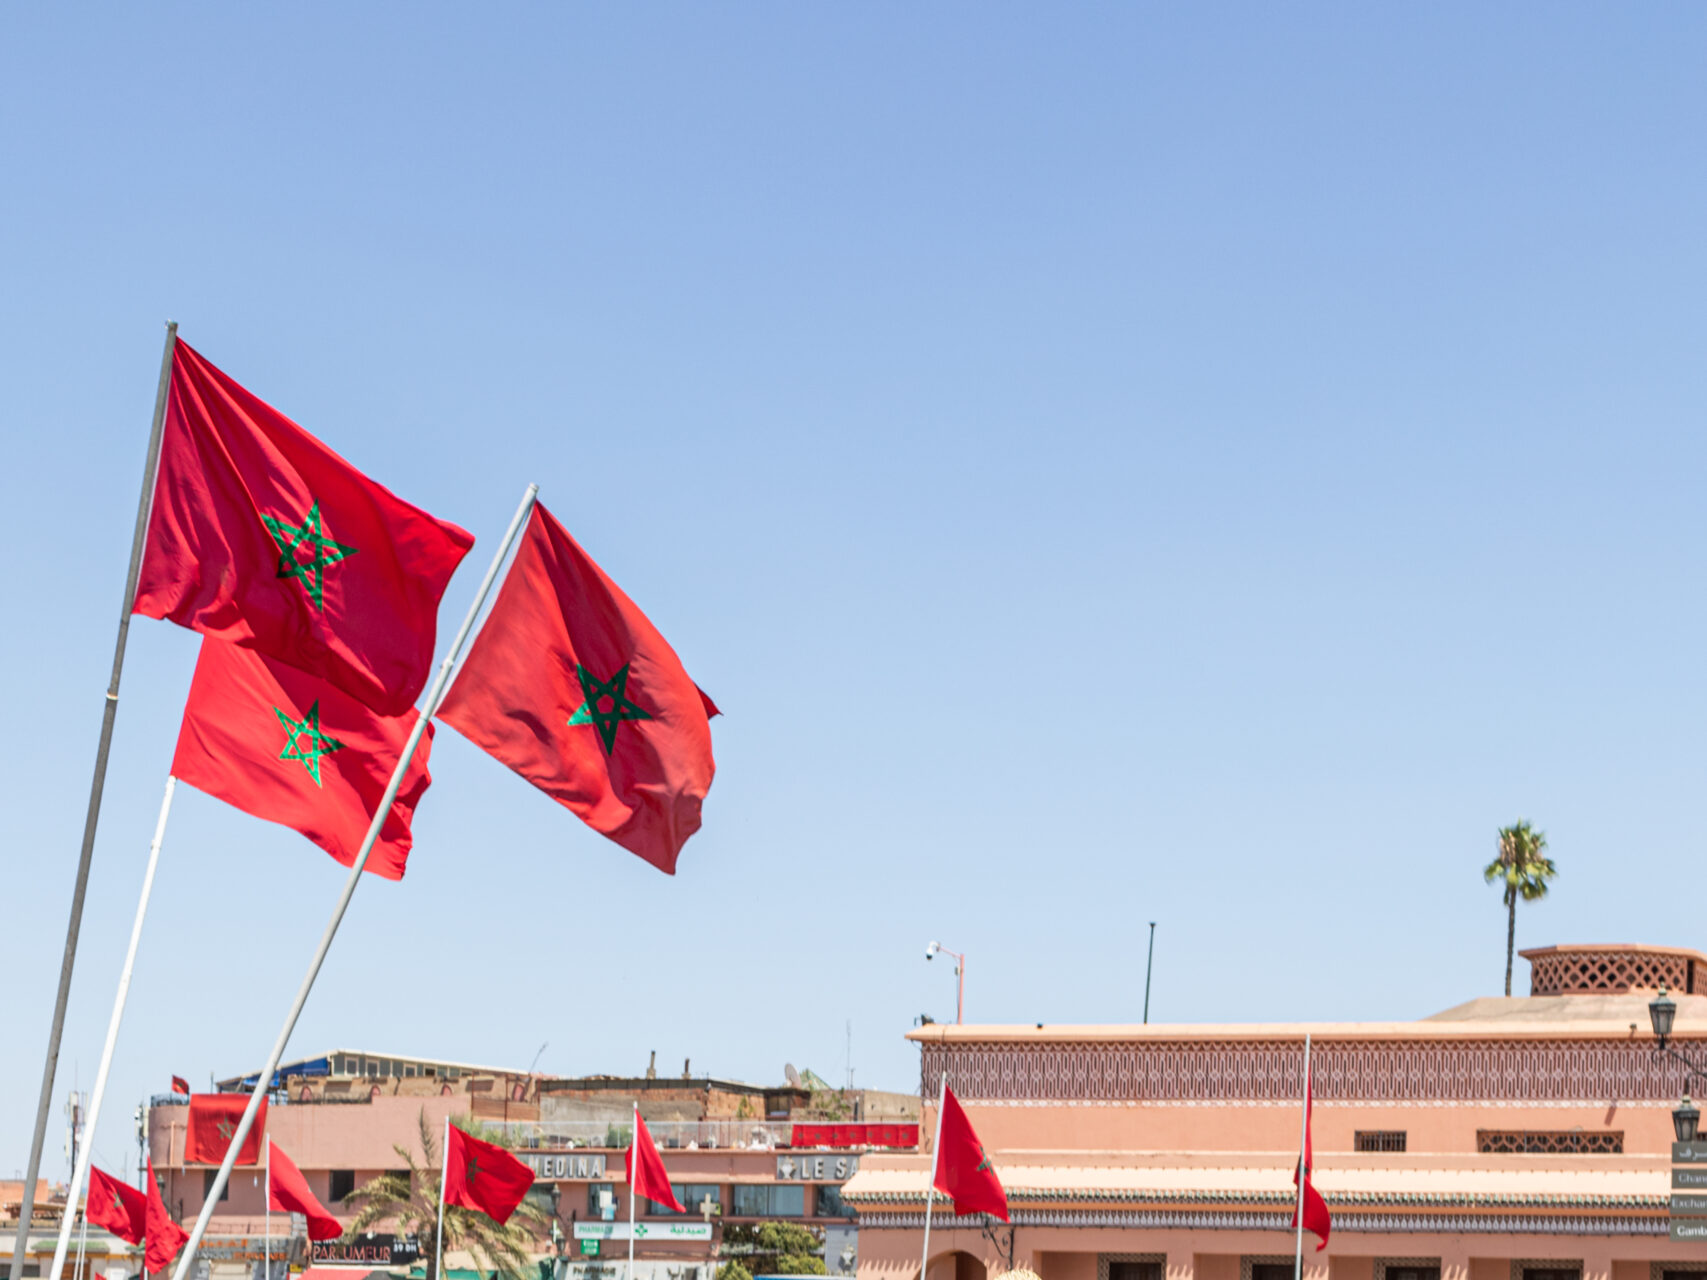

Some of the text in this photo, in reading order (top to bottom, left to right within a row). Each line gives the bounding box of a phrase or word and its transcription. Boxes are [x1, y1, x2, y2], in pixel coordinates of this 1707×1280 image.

[528, 1155, 602, 1177] MEDINA
[802, 1158, 824, 1178] LE
[313, 1245, 391, 1260] PARUMEUR
